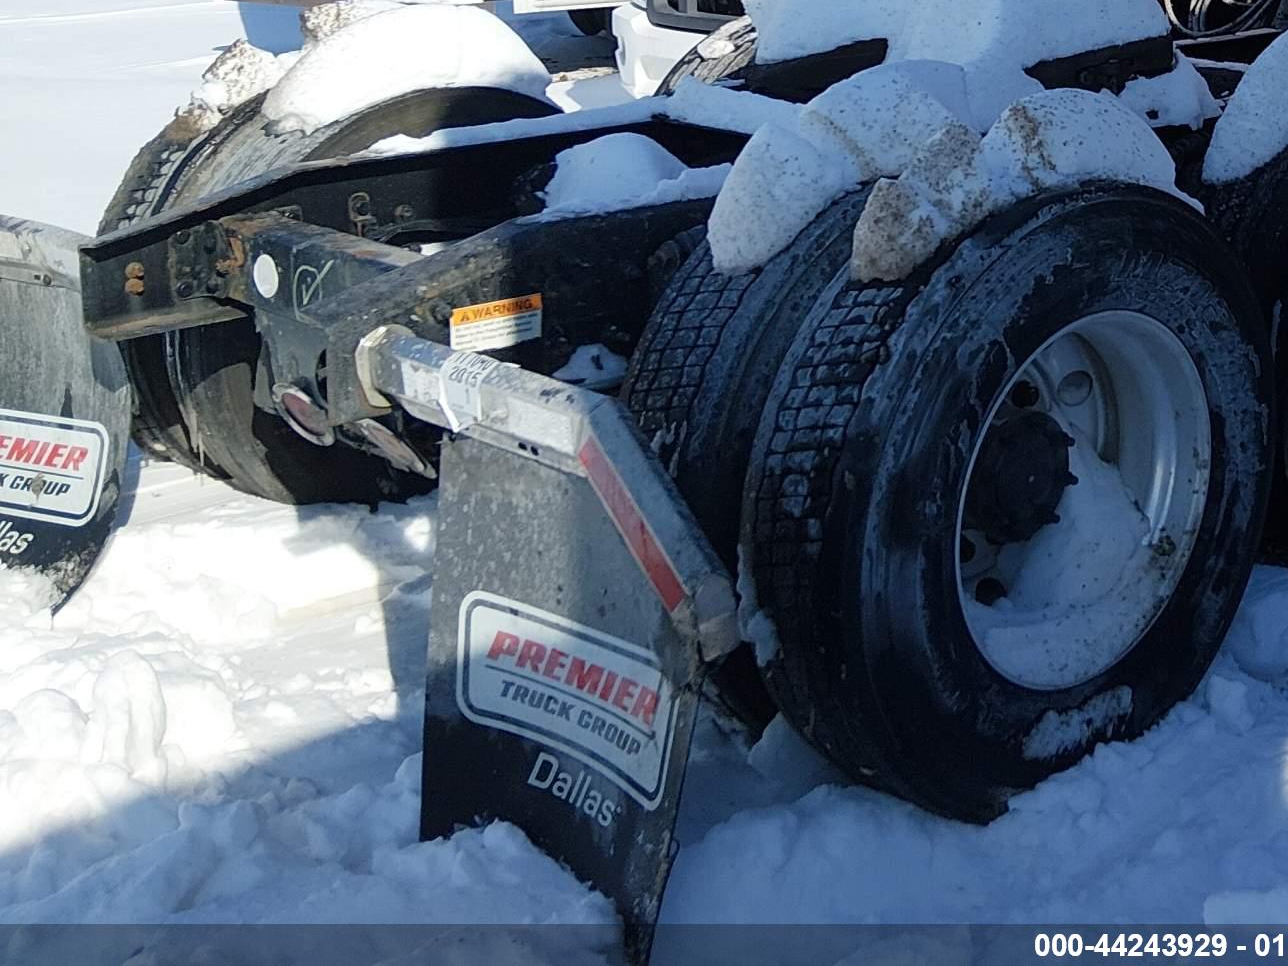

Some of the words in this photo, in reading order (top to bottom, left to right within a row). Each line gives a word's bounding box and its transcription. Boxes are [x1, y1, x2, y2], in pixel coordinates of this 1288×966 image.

[471, 298, 533, 320] WARNING
[449, 365, 482, 388] 2015
[486, 630, 661, 727] PREMIER
[499, 679, 576, 722] TRUCK
[576, 707, 642, 756] GROUP
[527, 751, 616, 827] Dallas
